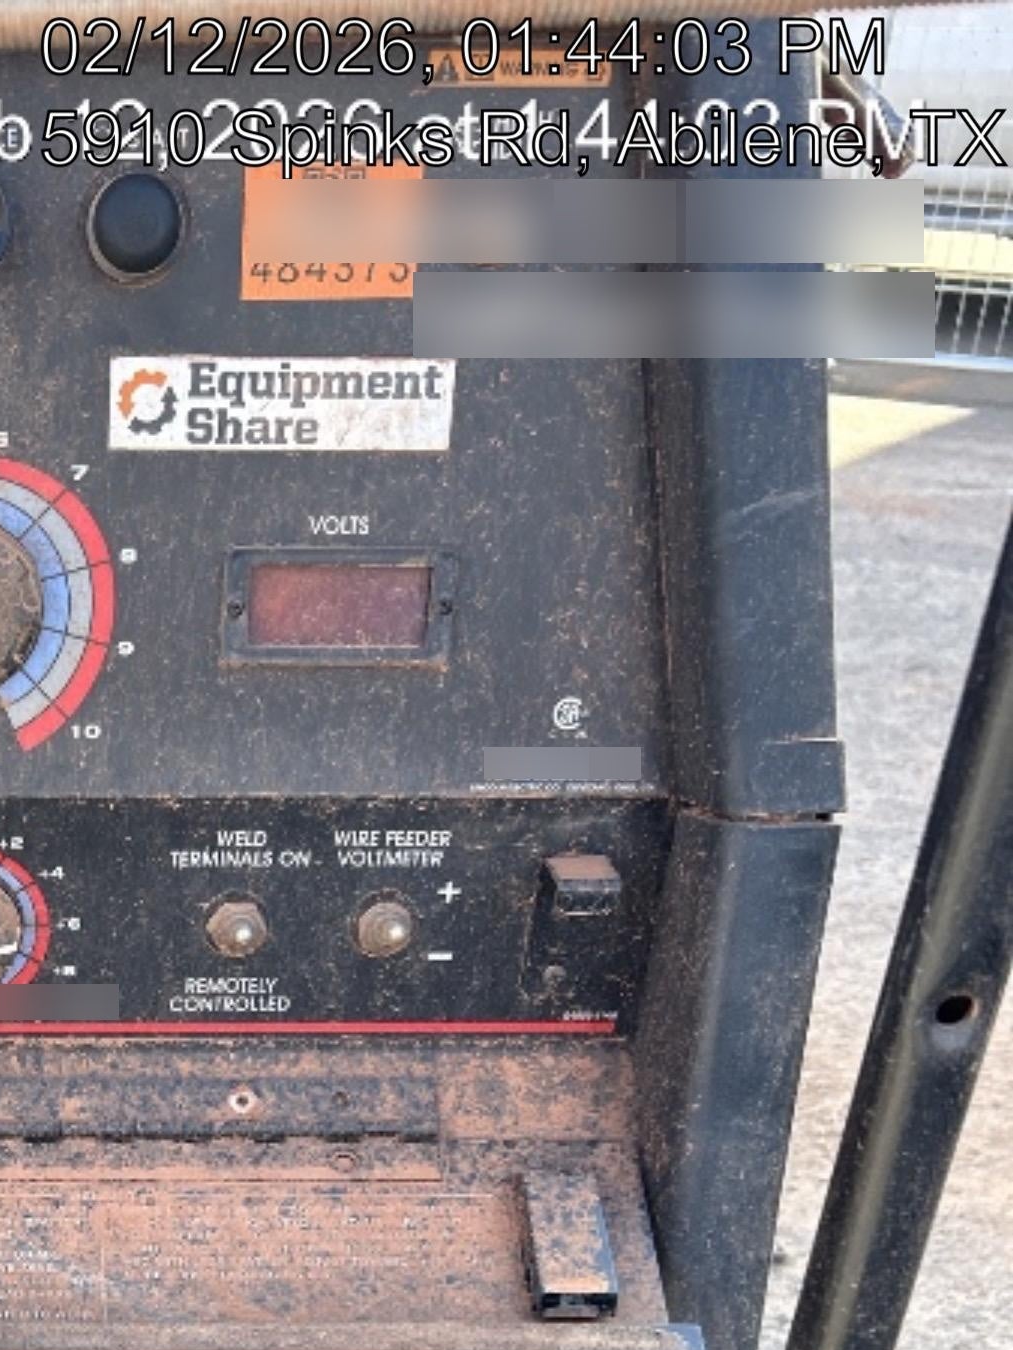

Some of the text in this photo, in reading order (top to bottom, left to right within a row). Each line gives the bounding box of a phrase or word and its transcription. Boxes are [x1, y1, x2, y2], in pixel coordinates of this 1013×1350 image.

[187, 362, 445, 409] Equipment
[187, 409, 320, 445] Share
[69, 464, 90, 482] 7
[307, 515, 370, 535] VOLTS
[70, 725, 102, 740] 10
[216, 829, 268, 848] WELD
[333, 829, 453, 848] WIRE FEEDER
[169, 848, 313, 870] TERMINALS ON
[337, 849, 445, 868] VOLTMETER
[184, 976, 280, 995] REMOTELY
[169, 995, 292, 1013] CONTROLLED
